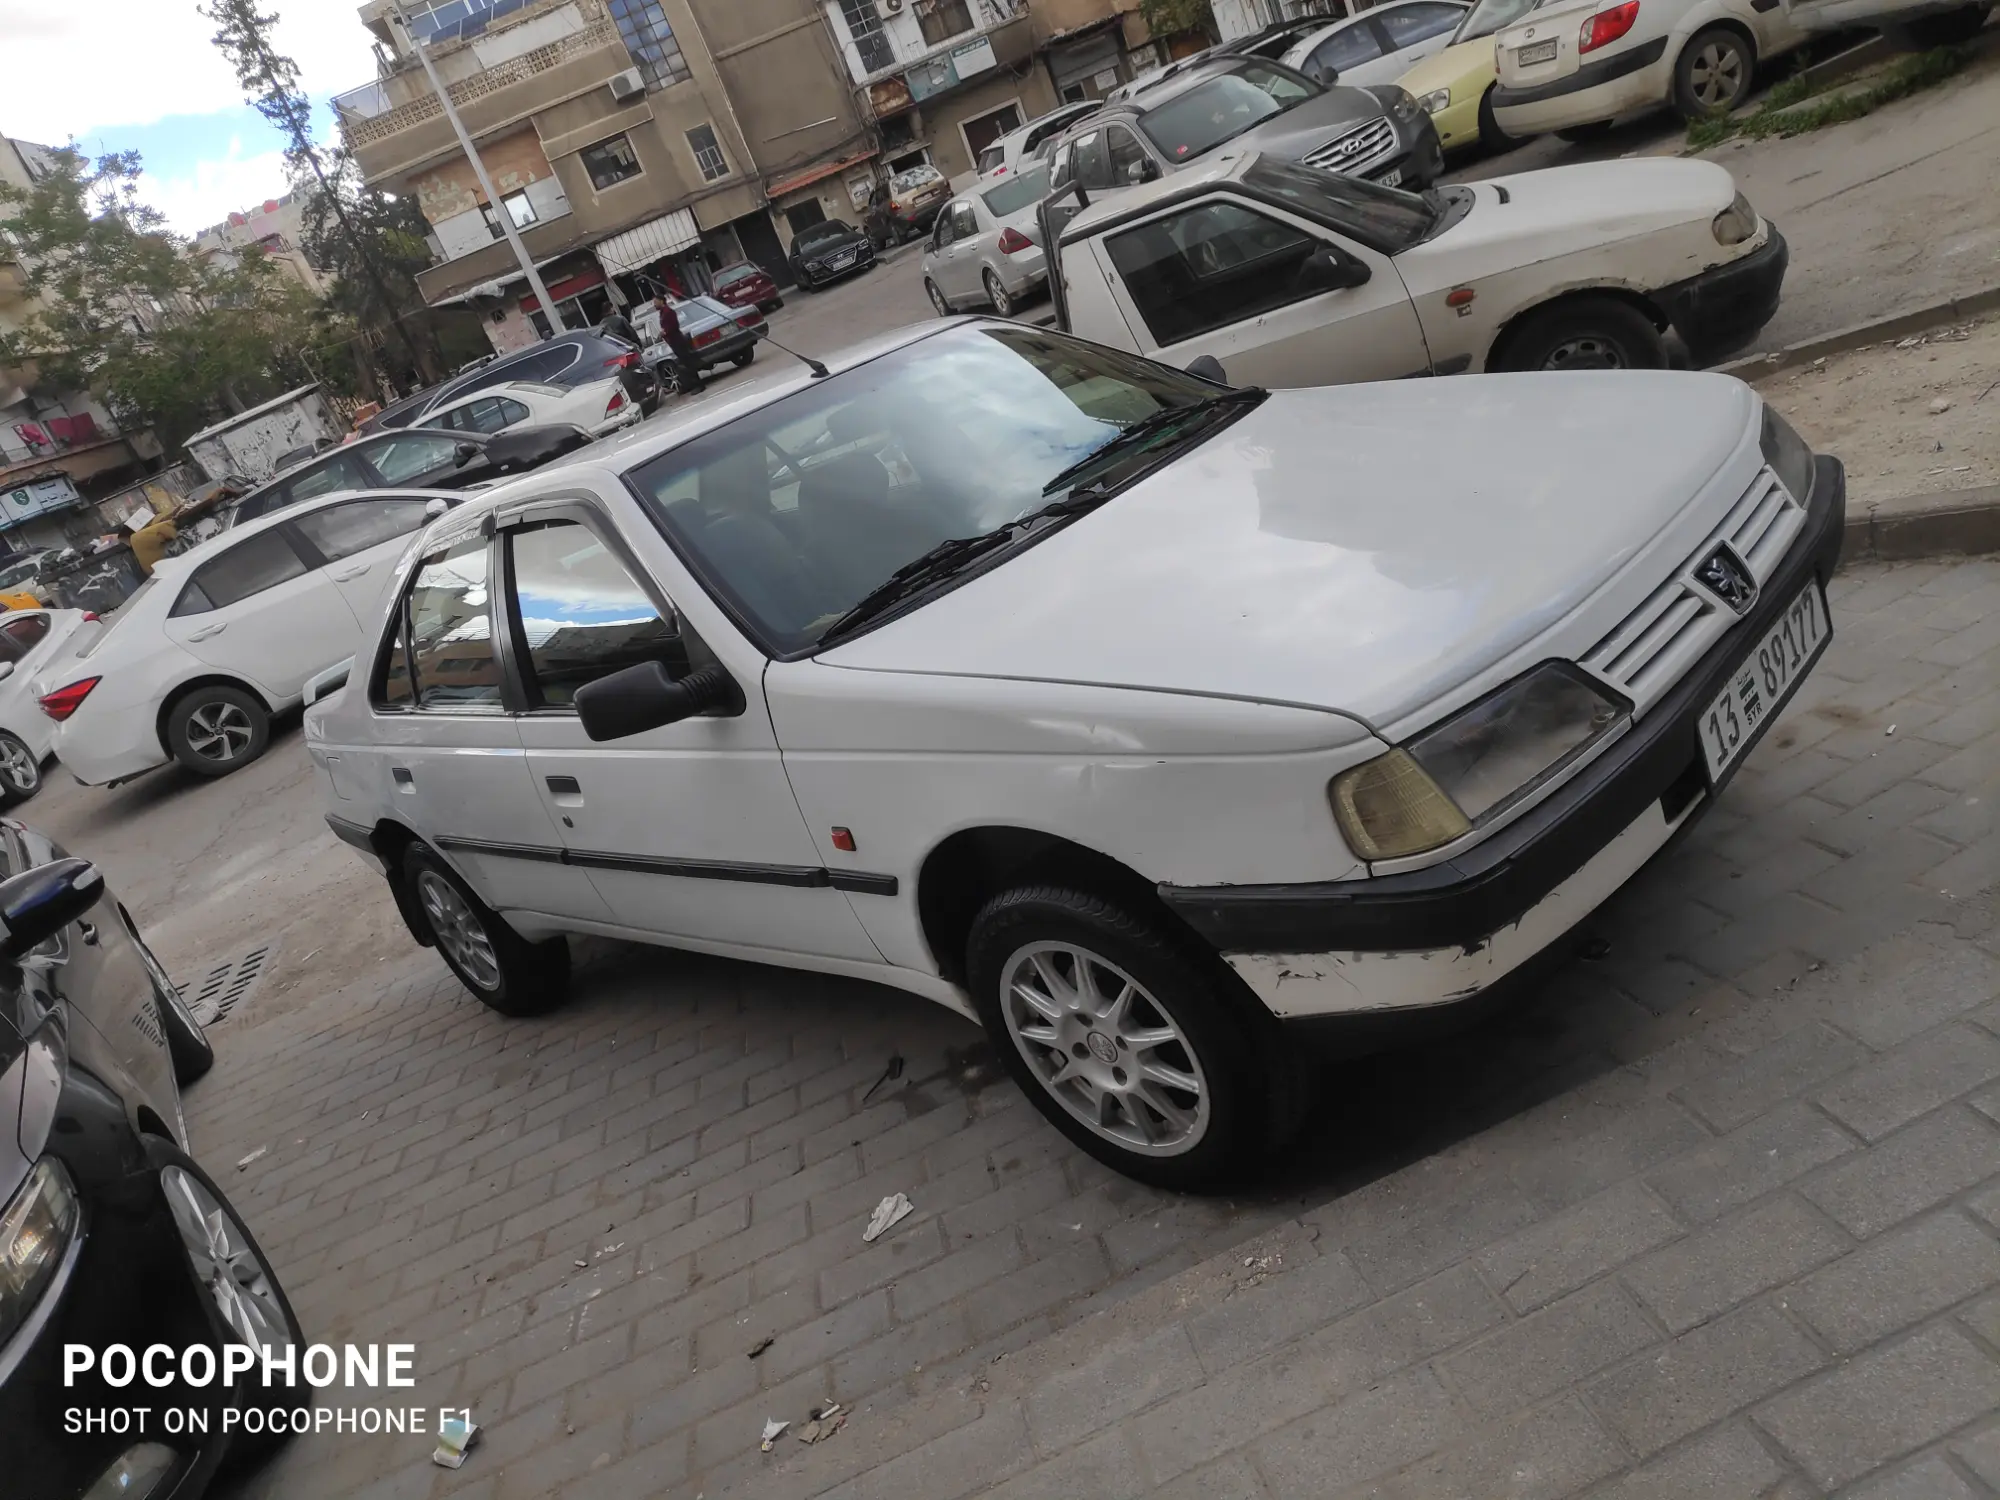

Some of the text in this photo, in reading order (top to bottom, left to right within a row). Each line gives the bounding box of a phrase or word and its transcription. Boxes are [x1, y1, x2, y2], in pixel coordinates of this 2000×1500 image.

[1709, 589, 1817, 767] 13 89177
[1747, 702, 1763, 726] SYR
